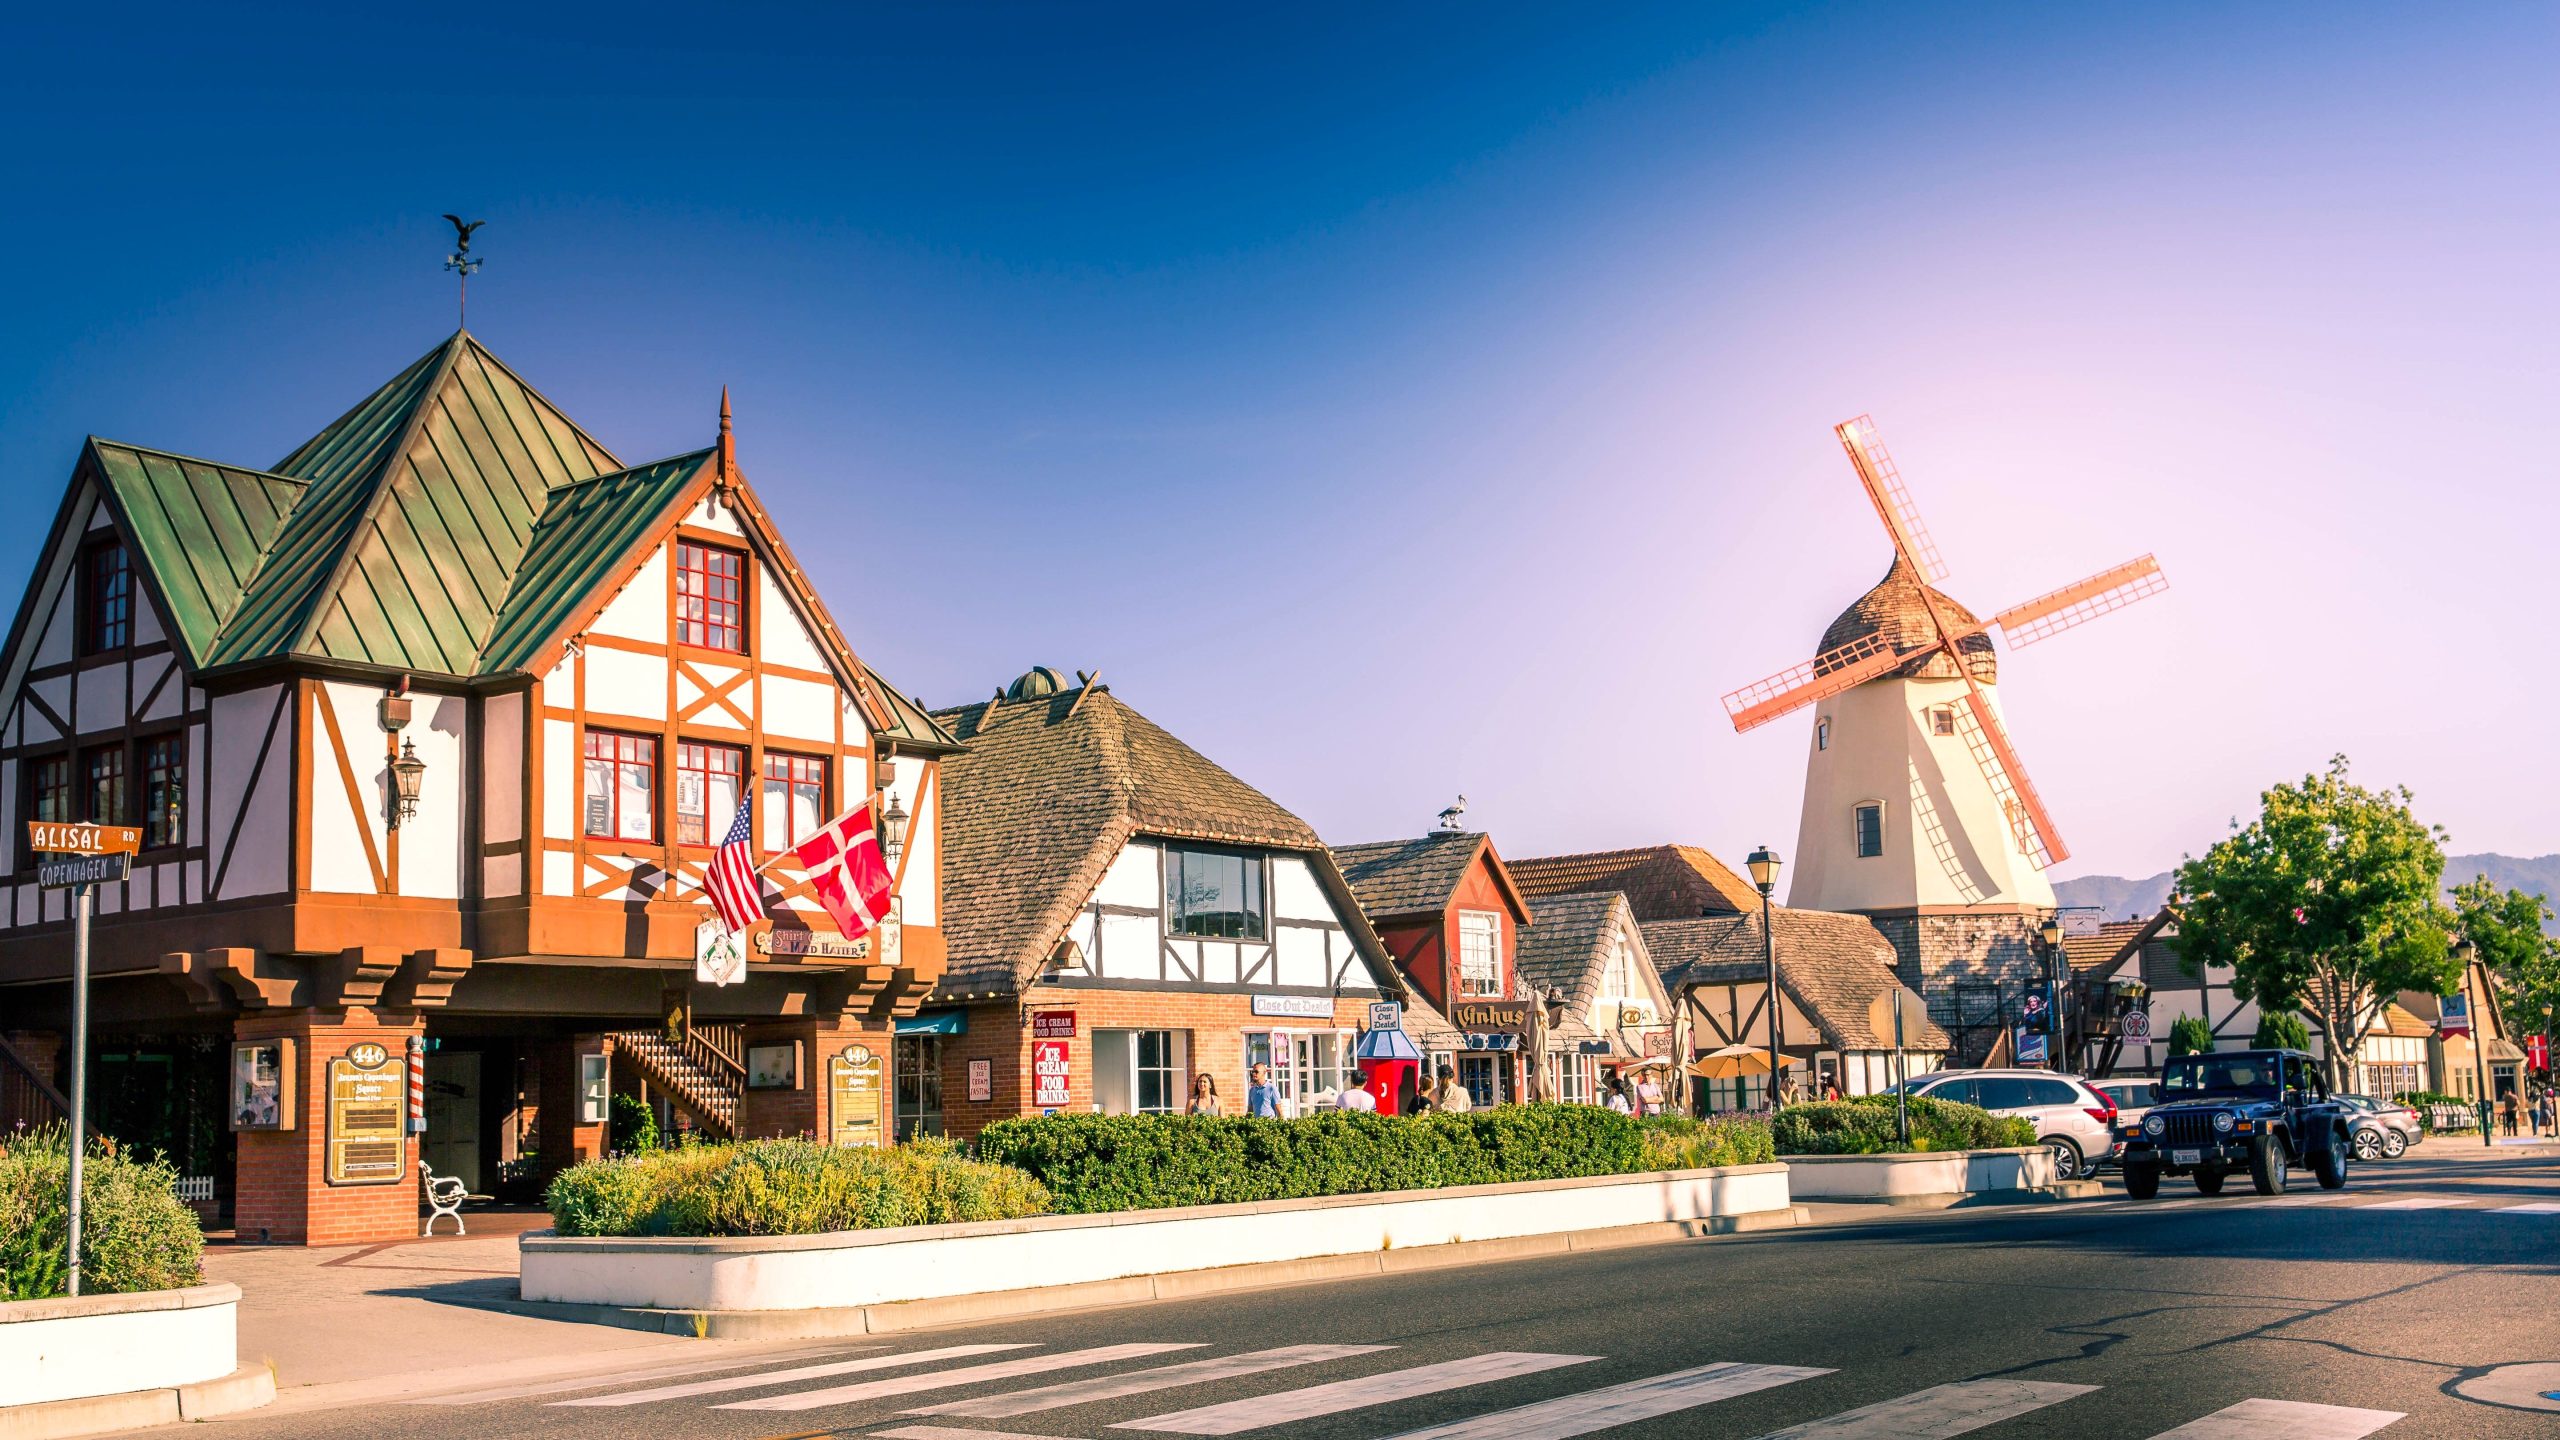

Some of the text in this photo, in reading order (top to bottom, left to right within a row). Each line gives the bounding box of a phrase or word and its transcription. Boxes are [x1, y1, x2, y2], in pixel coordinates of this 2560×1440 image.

[35, 826, 137, 850] ALISAL RD.
[41, 858, 108, 887] COPENHAGEN
[774, 930, 804, 948] Shirt
[808, 931, 844, 943] Galler
[790, 941, 818, 954] MAD
[1257, 999, 1281, 1011] Close
[1283, 1000, 1301, 1012] Out
[1374, 1005, 1394, 1013] Close
[1036, 1018, 1072, 1028] ICE CREAM
[1377, 1013, 1392, 1021] Out
[1457, 1005, 1525, 1028] Vinhus
[1373, 1020, 1396, 1029] Deals!
[1033, 1027, 1075, 1037] FOOD DRINKS
[1651, 1036, 1672, 1046] Solv
[354, 1047, 385, 1063] 446
[846, 1048, 869, 1062] 446
[1045, 1047, 1060, 1061] ICE
[973, 1062, 988, 1071] FREE
[1036, 1061, 1069, 1075] CREAM
[971, 1078, 989, 1086] CREAM
[1041, 1076, 1065, 1090] FOOD
[356, 1083, 382, 1096] Square
[1037, 1090, 1070, 1104] DRINKS
